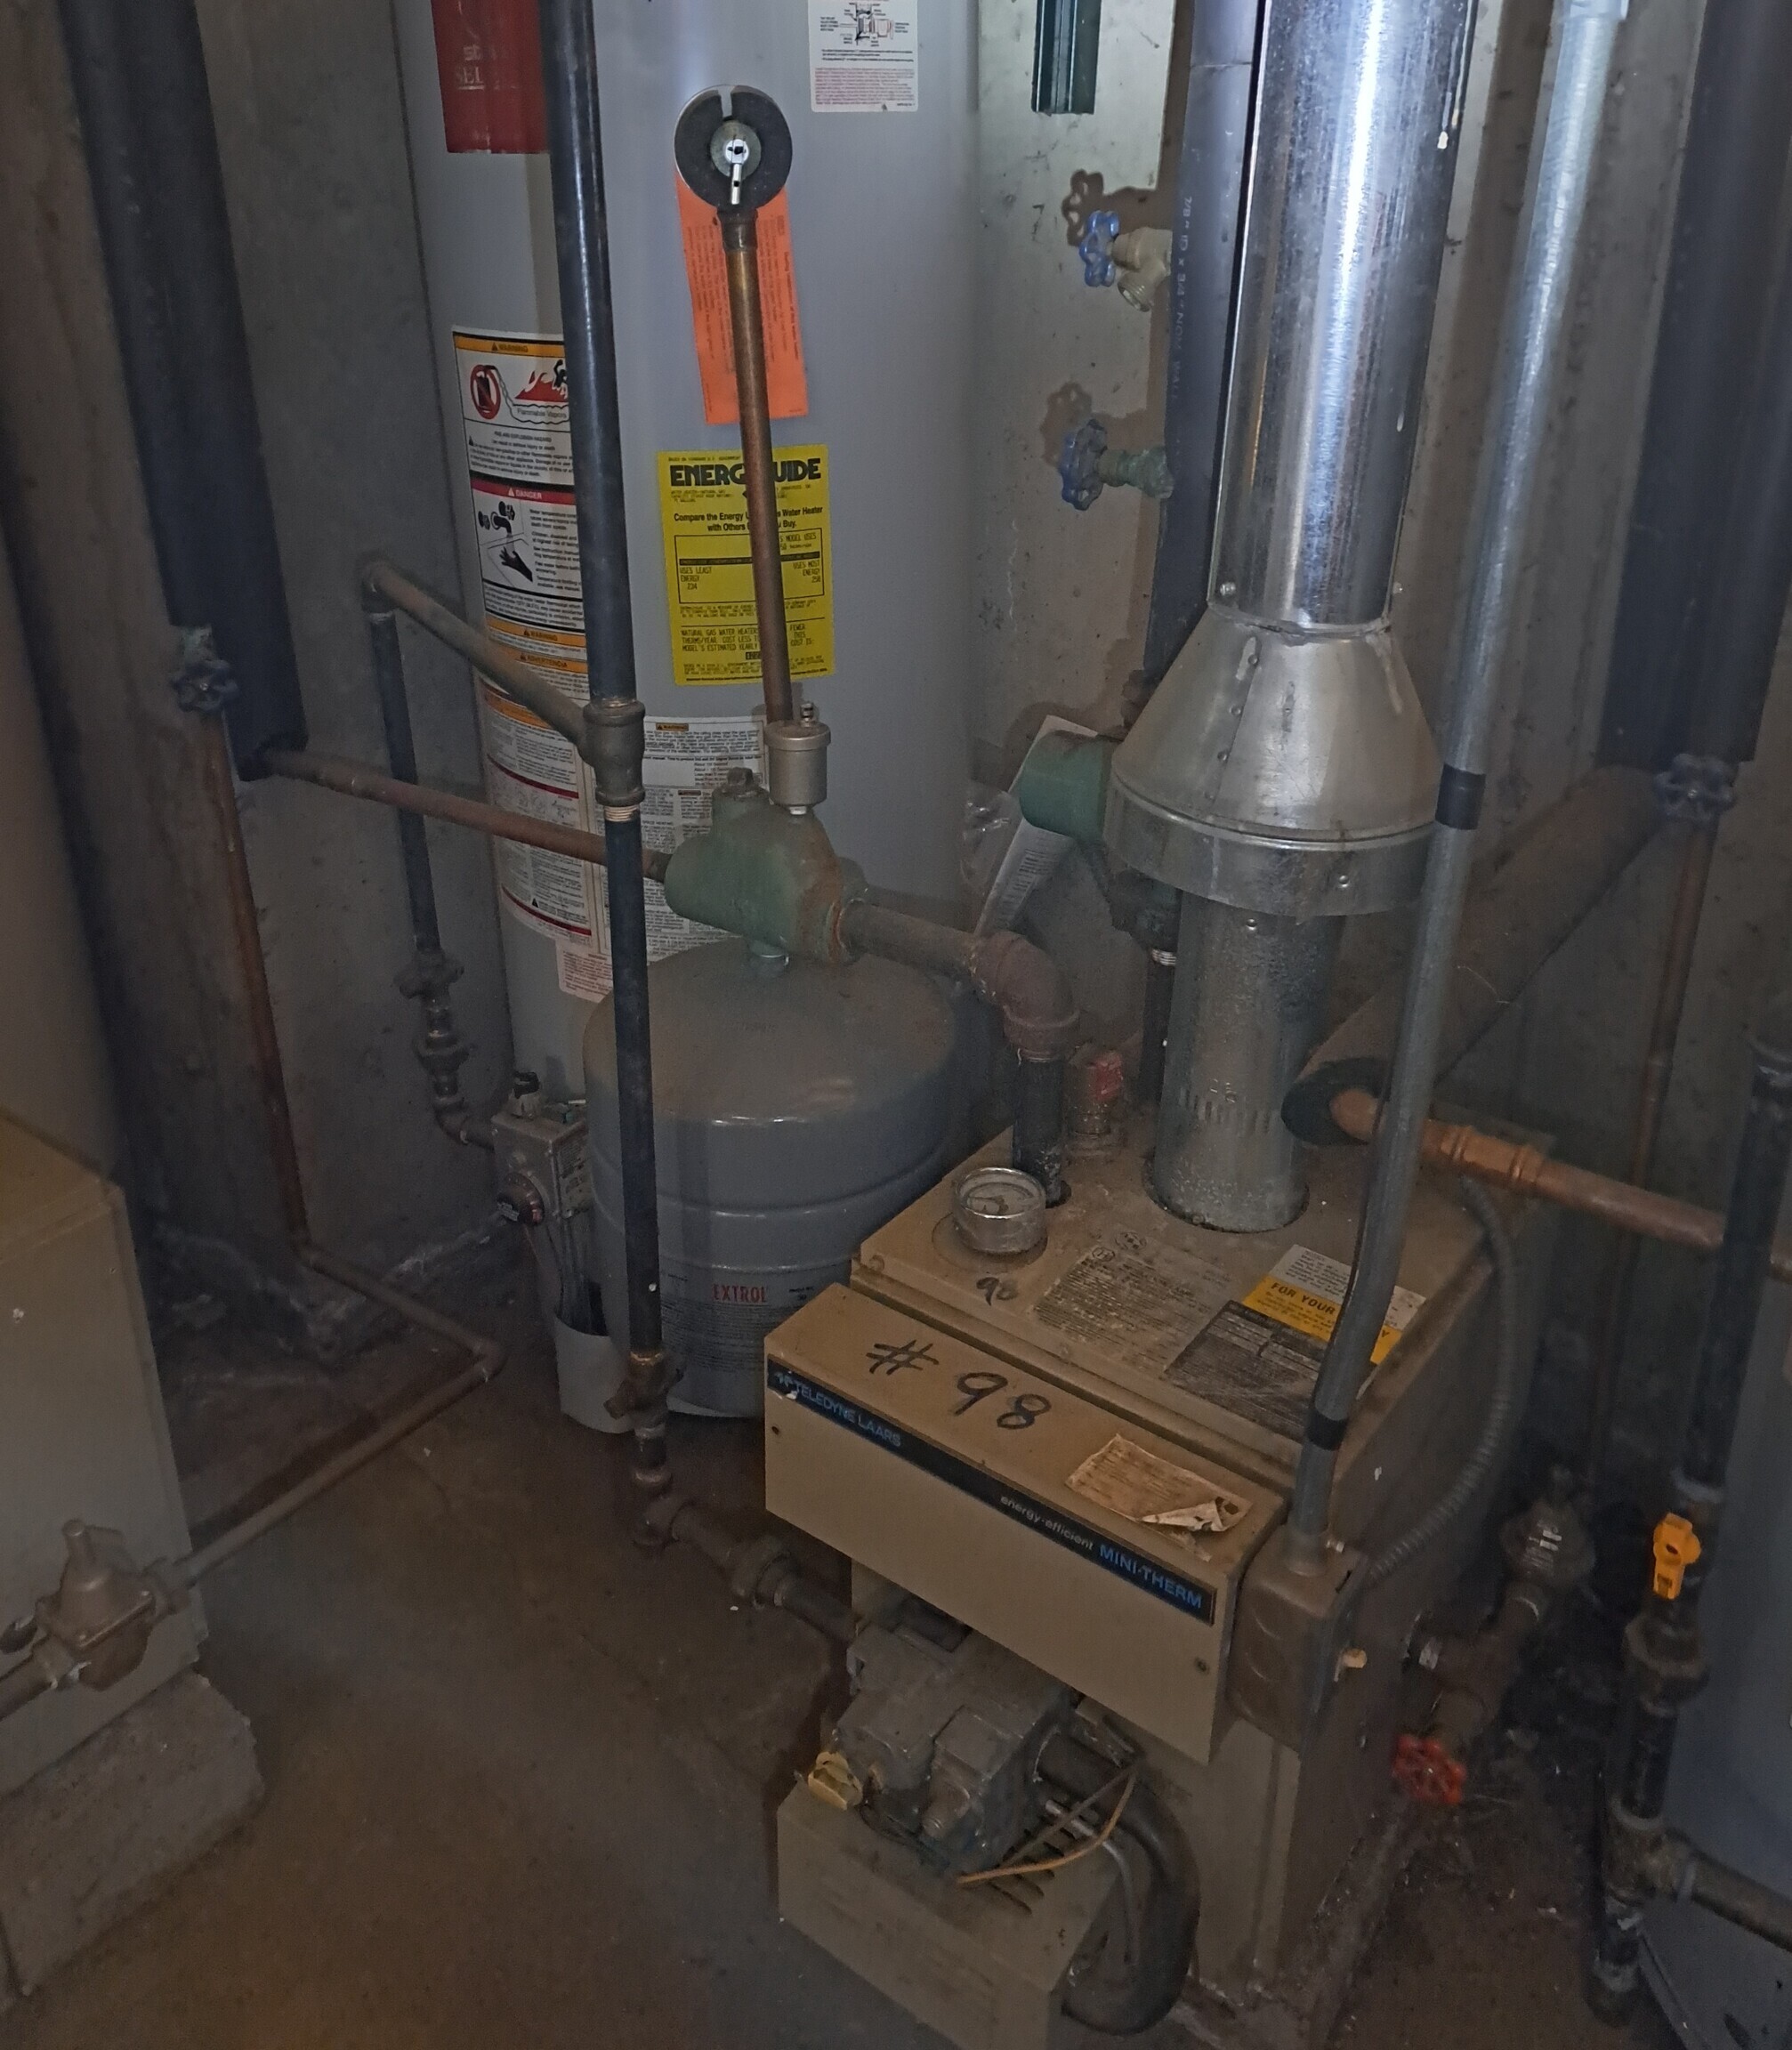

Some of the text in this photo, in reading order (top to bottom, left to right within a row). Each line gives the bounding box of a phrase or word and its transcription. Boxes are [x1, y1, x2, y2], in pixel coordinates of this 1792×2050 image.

[498, 343, 529, 353] WARNING
[516, 489, 542, 499] DANGER
[674, 512, 706, 524] Compare
[706, 512, 718, 521] the
[719, 511, 744, 523] Energy
[783, 508, 802, 518] Water
[802, 504, 824, 515] Heater
[707, 520, 797, 531] with Others Buy.
[786, 532, 816, 542] MODEL USES
[792, 560, 820, 569] USES MOST
[680, 566, 713, 575] USES LEAST
[803, 569, 820, 577] ENERGY
[681, 575, 700, 583] ENERGY
[682, 628, 703, 637] NATURAL
[706, 628, 717, 636] GAS
[719, 627, 735, 635] WATER
[790, 623, 806, 632] FEWER
[529, 631, 558, 642] WARNING
[682, 636, 717, 644] THERMS/YEAR
[706, 643, 737, 651] ESTIMATED
[739, 642, 758, 650] YEARLY
[790, 639, 804, 647] COST
[712, 1284, 768, 1303] EXTROL
[1271, 1282, 1297, 1299] FOR
[1300, 1295, 1336, 1315] YOUR
[867, 1339, 1052, 1430] # 98
[794, 1380, 902, 1448] TELEDYNE LAARS
